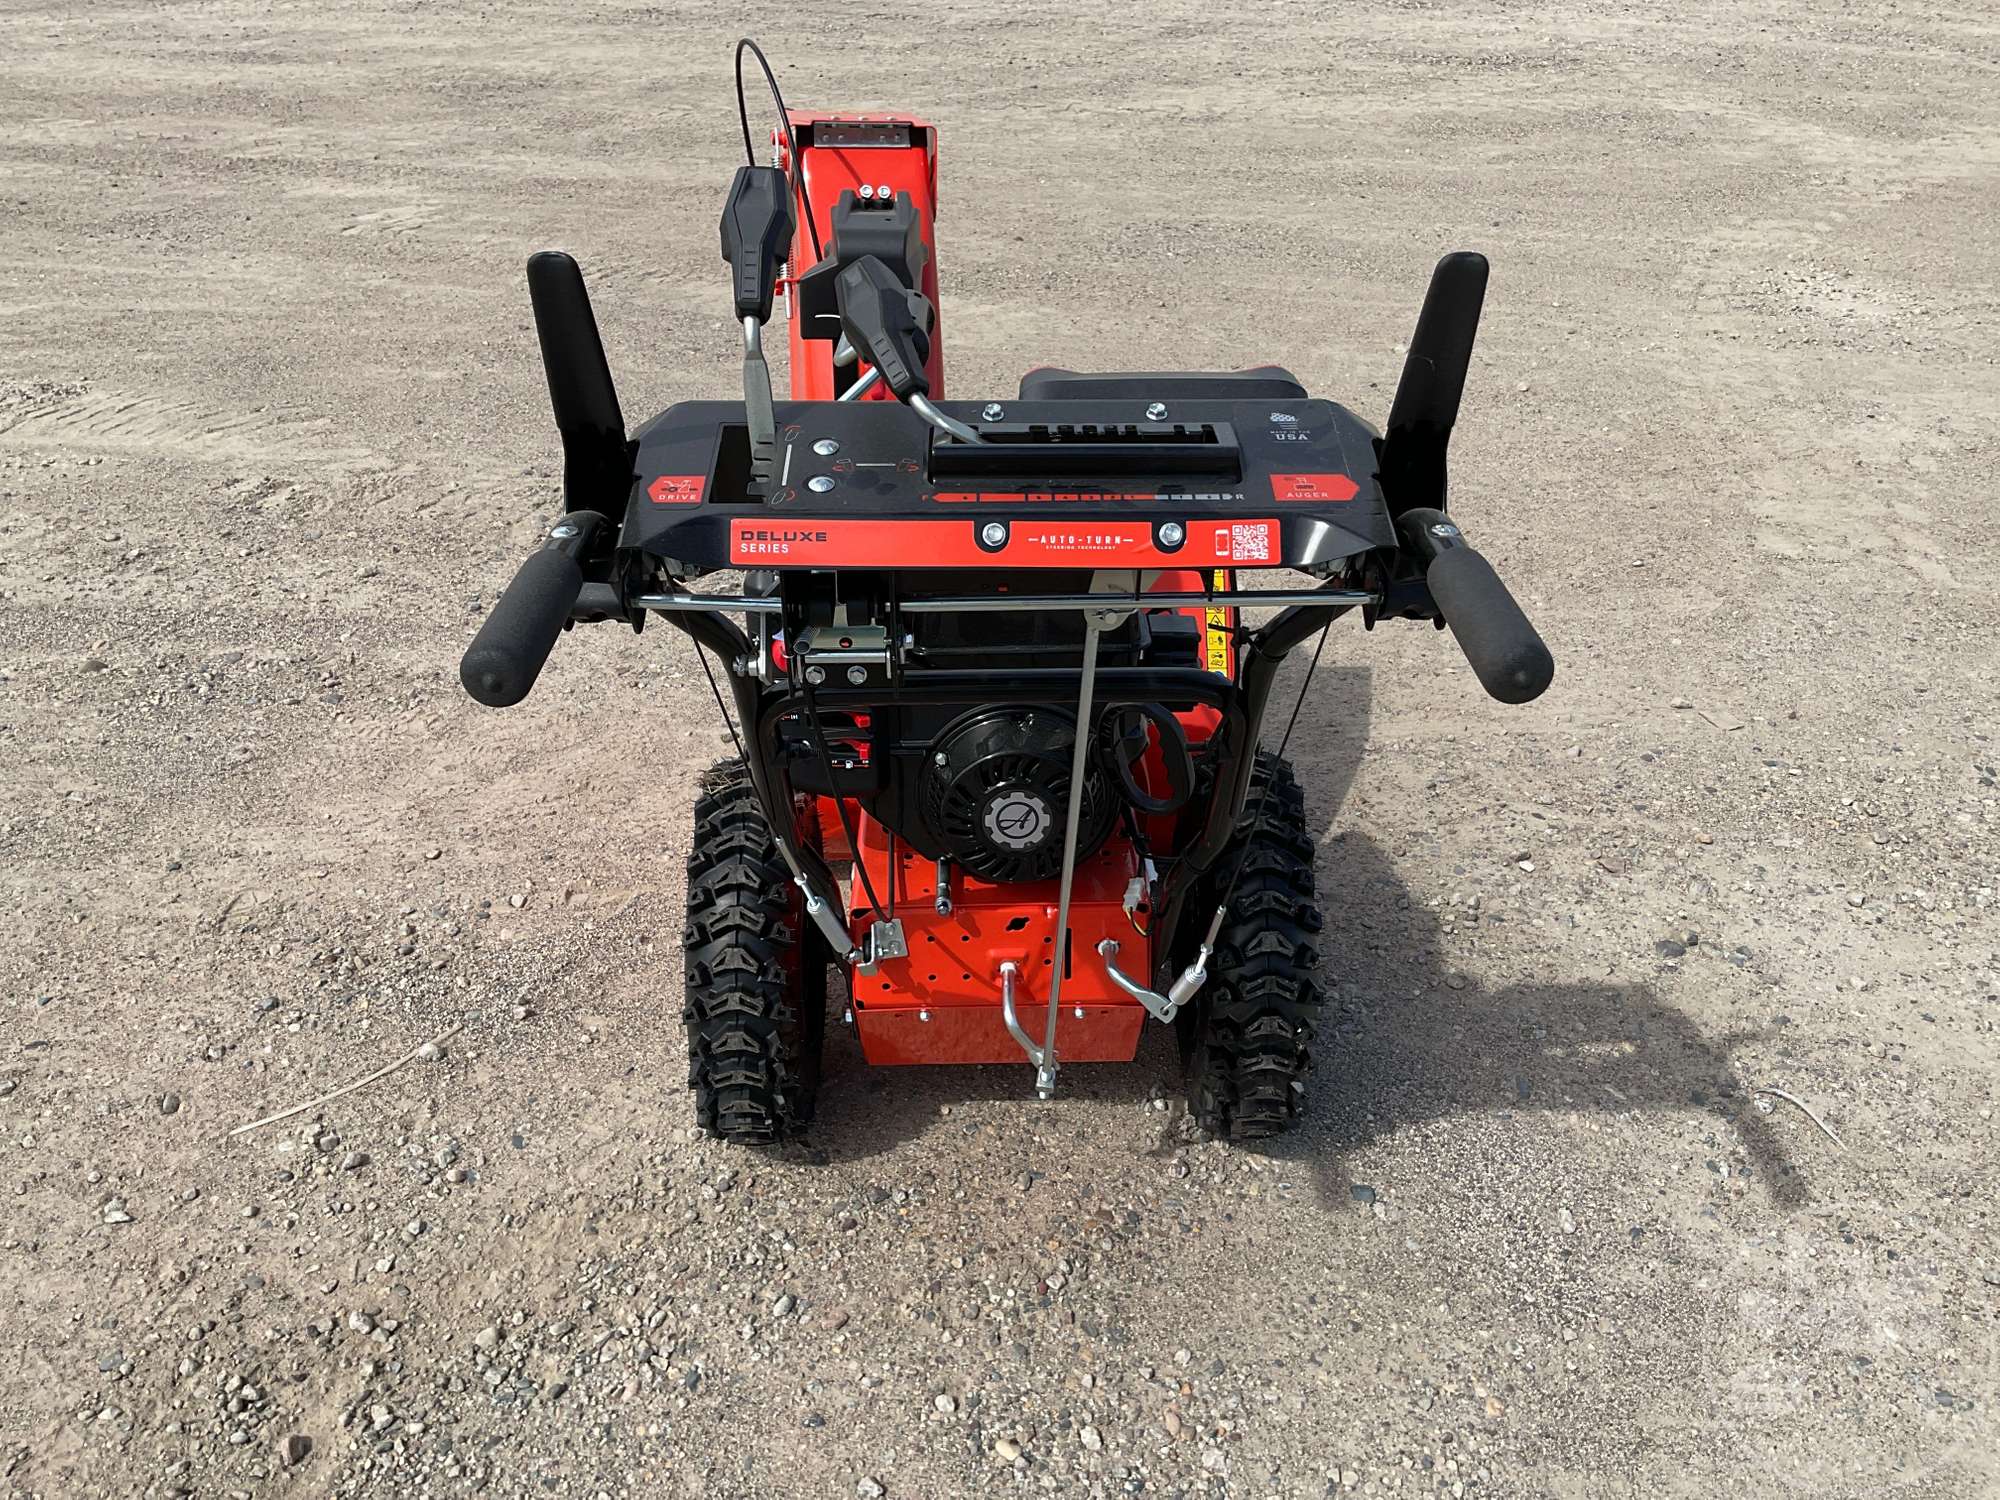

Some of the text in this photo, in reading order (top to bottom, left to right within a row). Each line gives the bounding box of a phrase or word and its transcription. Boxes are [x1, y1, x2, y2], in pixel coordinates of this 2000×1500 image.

[1276, 433, 1309, 441] USA
[741, 530, 828, 542] DELUXE
[1040, 535, 1121, 545] AUTO-TURN
[741, 543, 789, 554] SERIES
